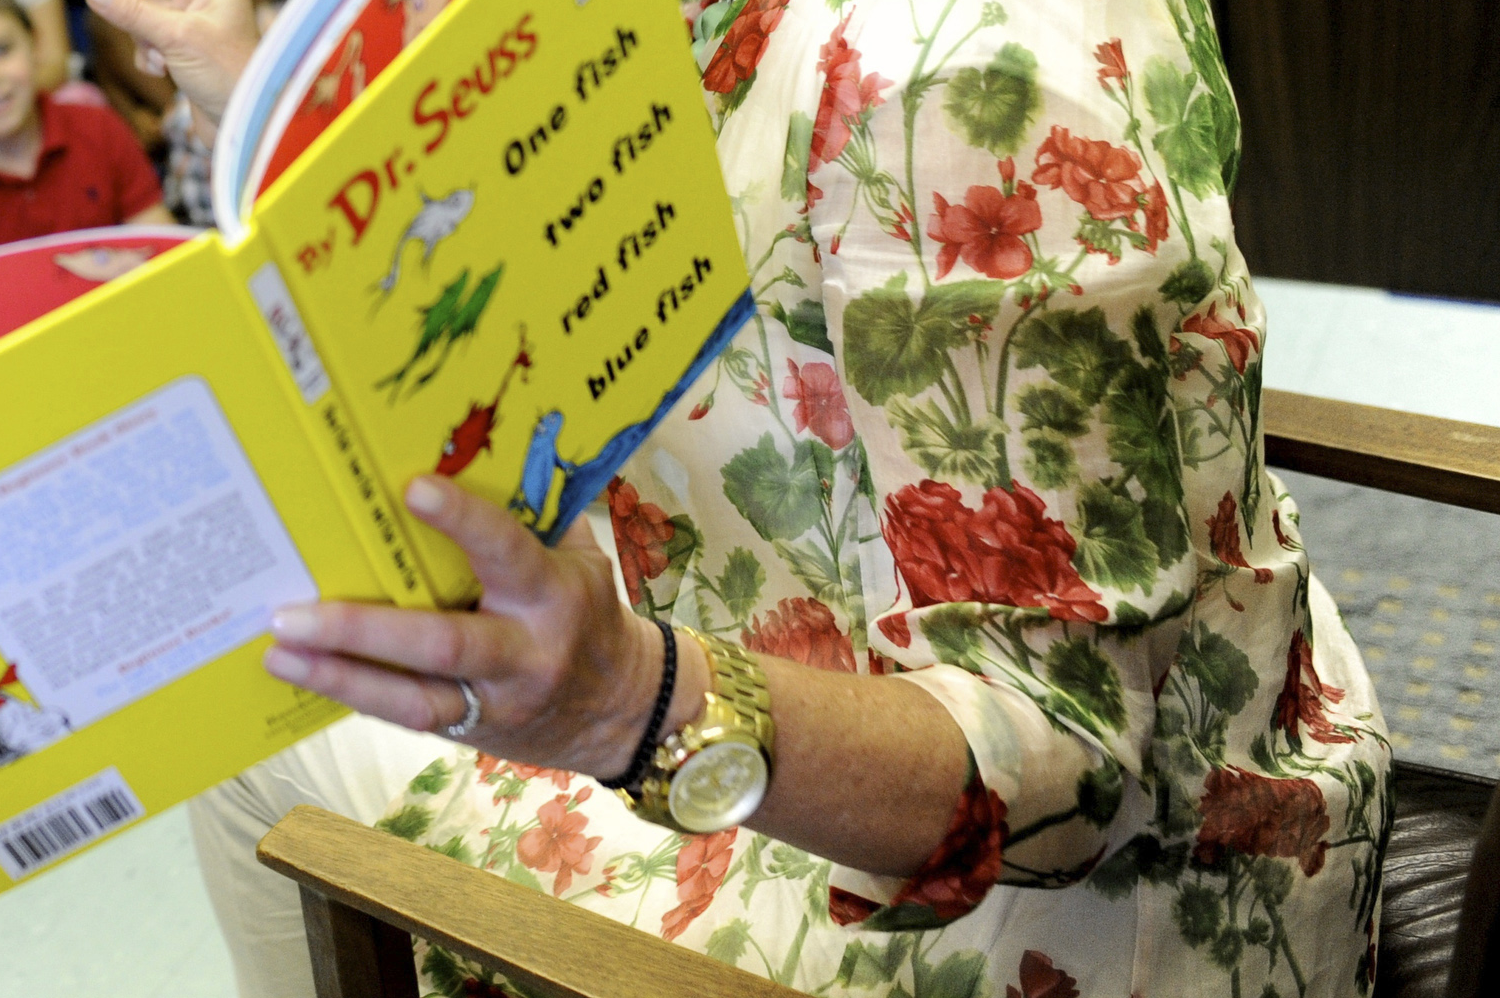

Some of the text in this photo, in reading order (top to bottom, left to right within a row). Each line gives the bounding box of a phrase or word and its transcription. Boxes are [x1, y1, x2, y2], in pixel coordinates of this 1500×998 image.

[329, 150, 415, 243] Dr.
[412, 14, 538, 154] Seuss
[502, 104, 567, 178] One
[574, 25, 640, 102] fish
[543, 101, 674, 249] two fish
[560, 200, 677, 336] red fish
[586, 255, 714, 402] blue fish
